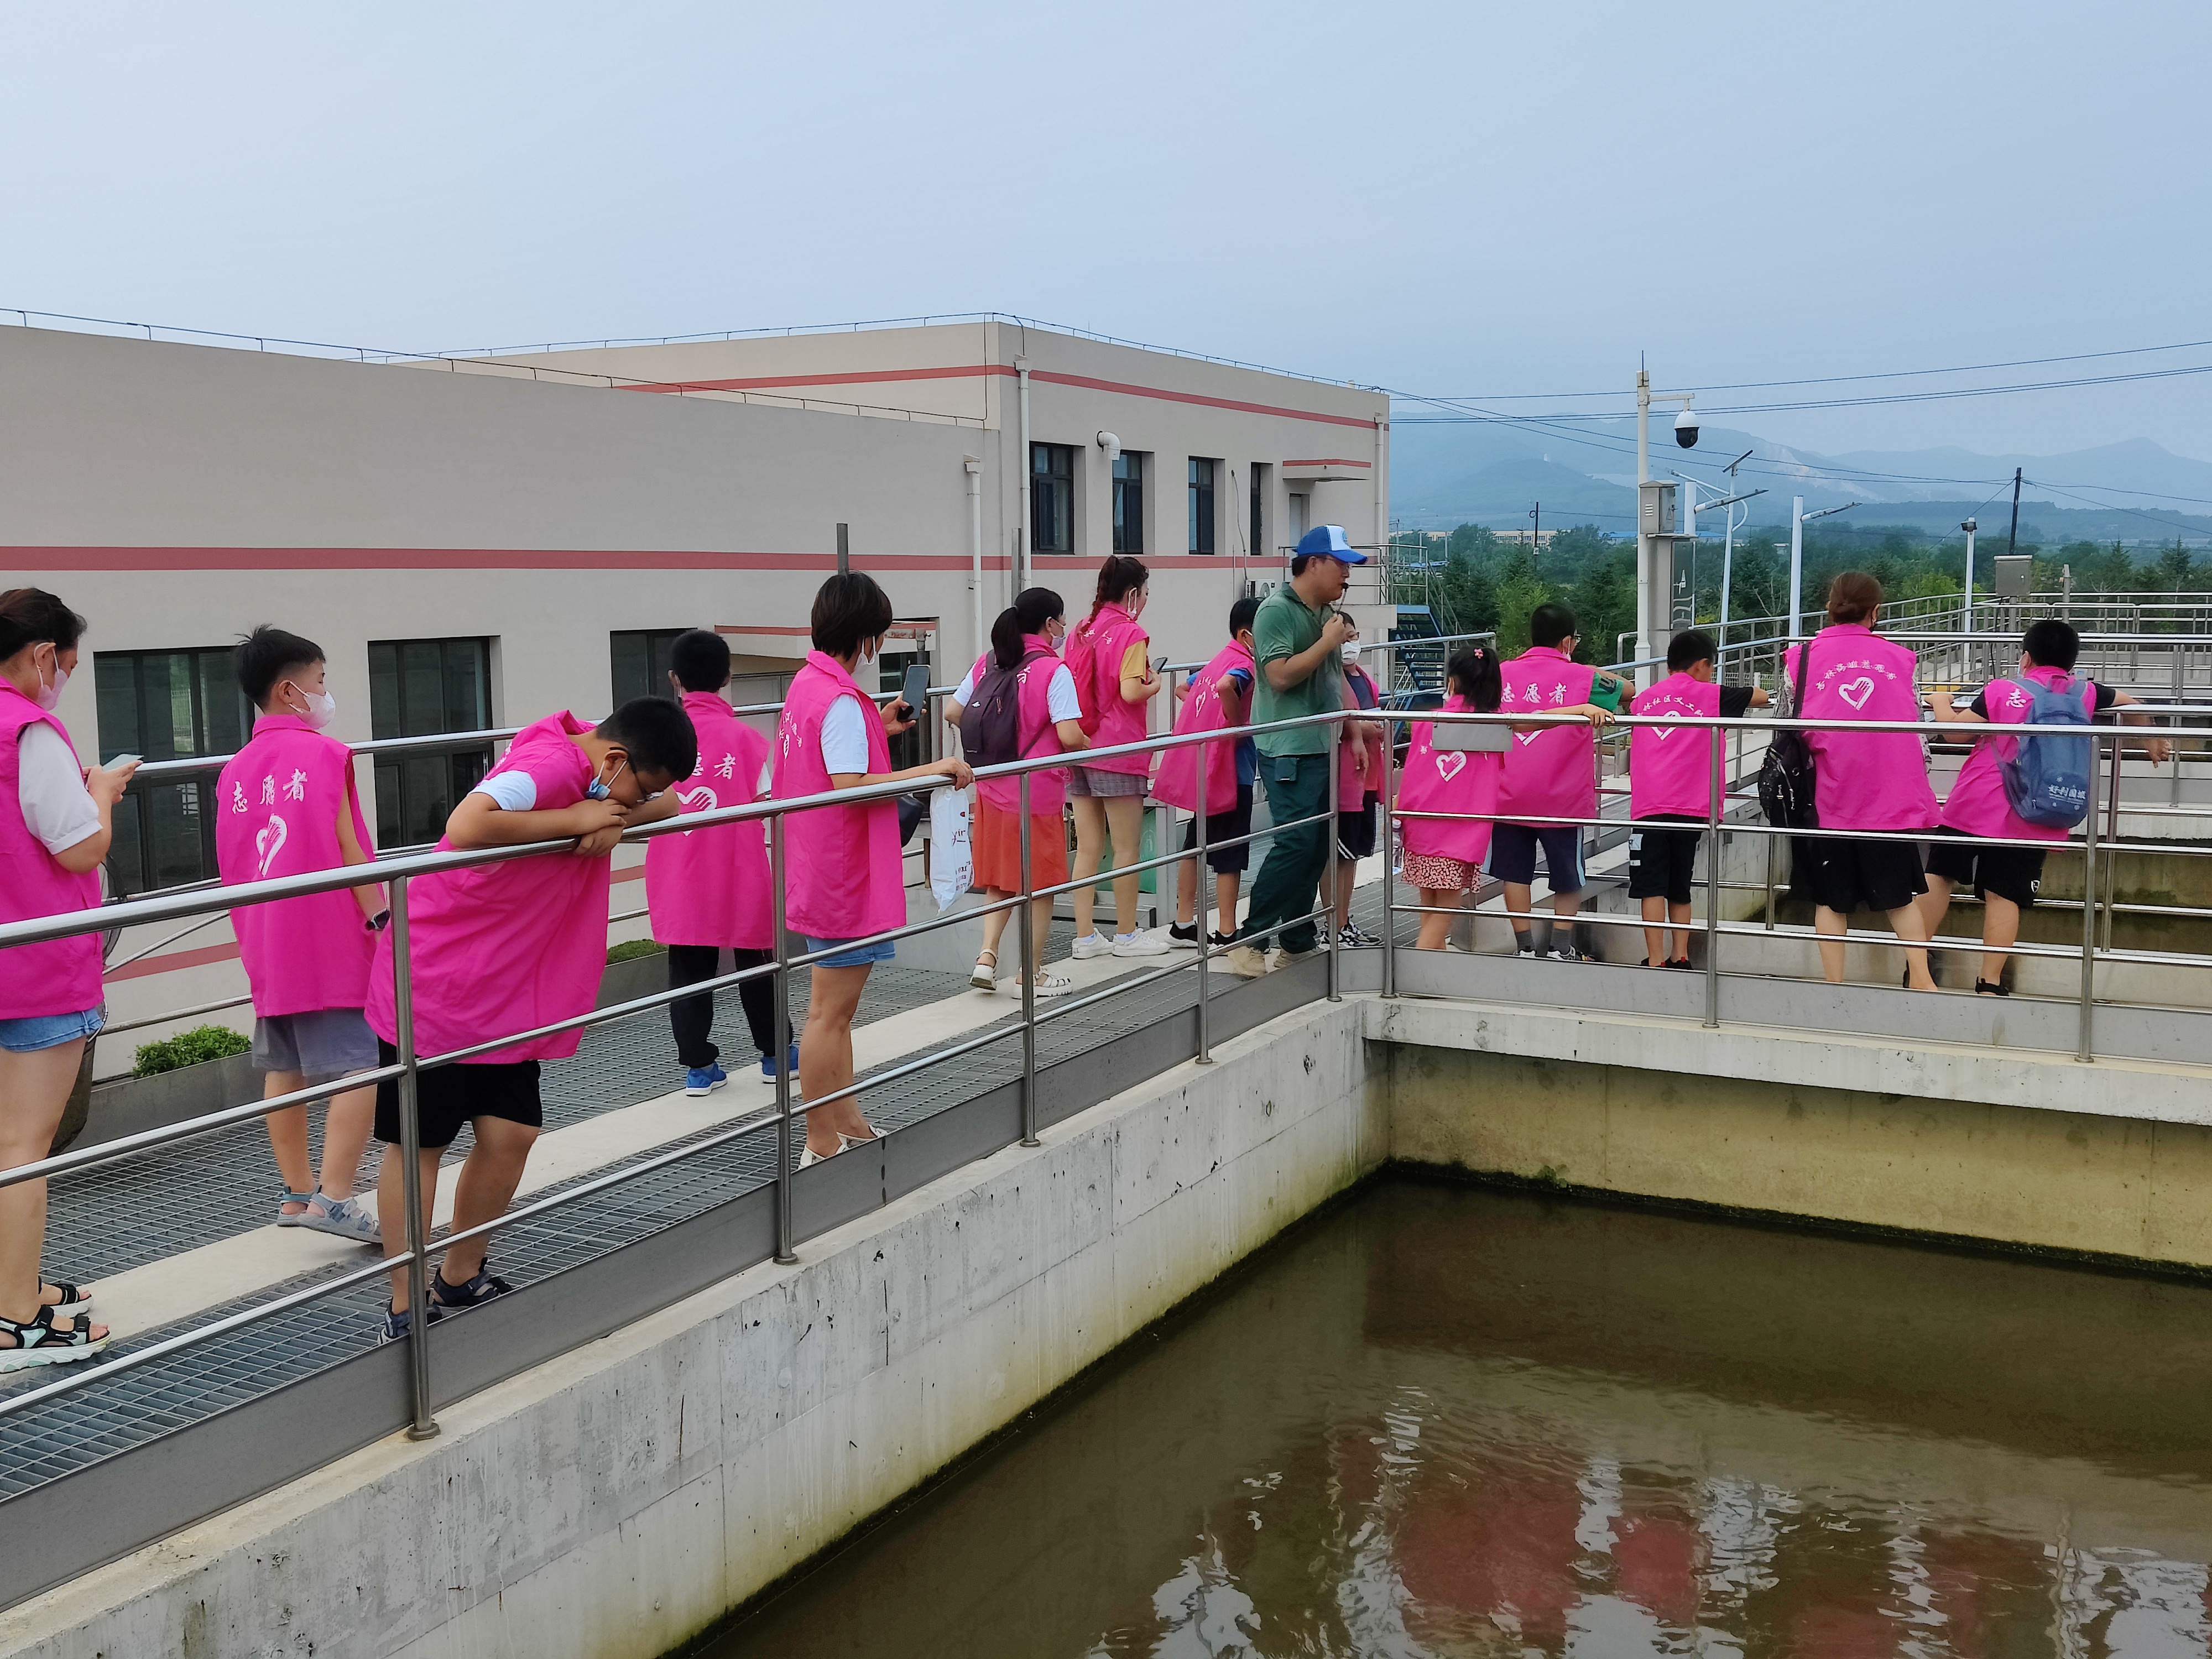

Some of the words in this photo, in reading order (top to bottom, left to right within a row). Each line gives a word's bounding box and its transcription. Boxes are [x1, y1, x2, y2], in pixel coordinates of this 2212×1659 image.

[1501, 682, 1567, 705] 志愿者
[2005, 688, 2027, 707] 志
[232, 768, 307, 814] 志愿者
